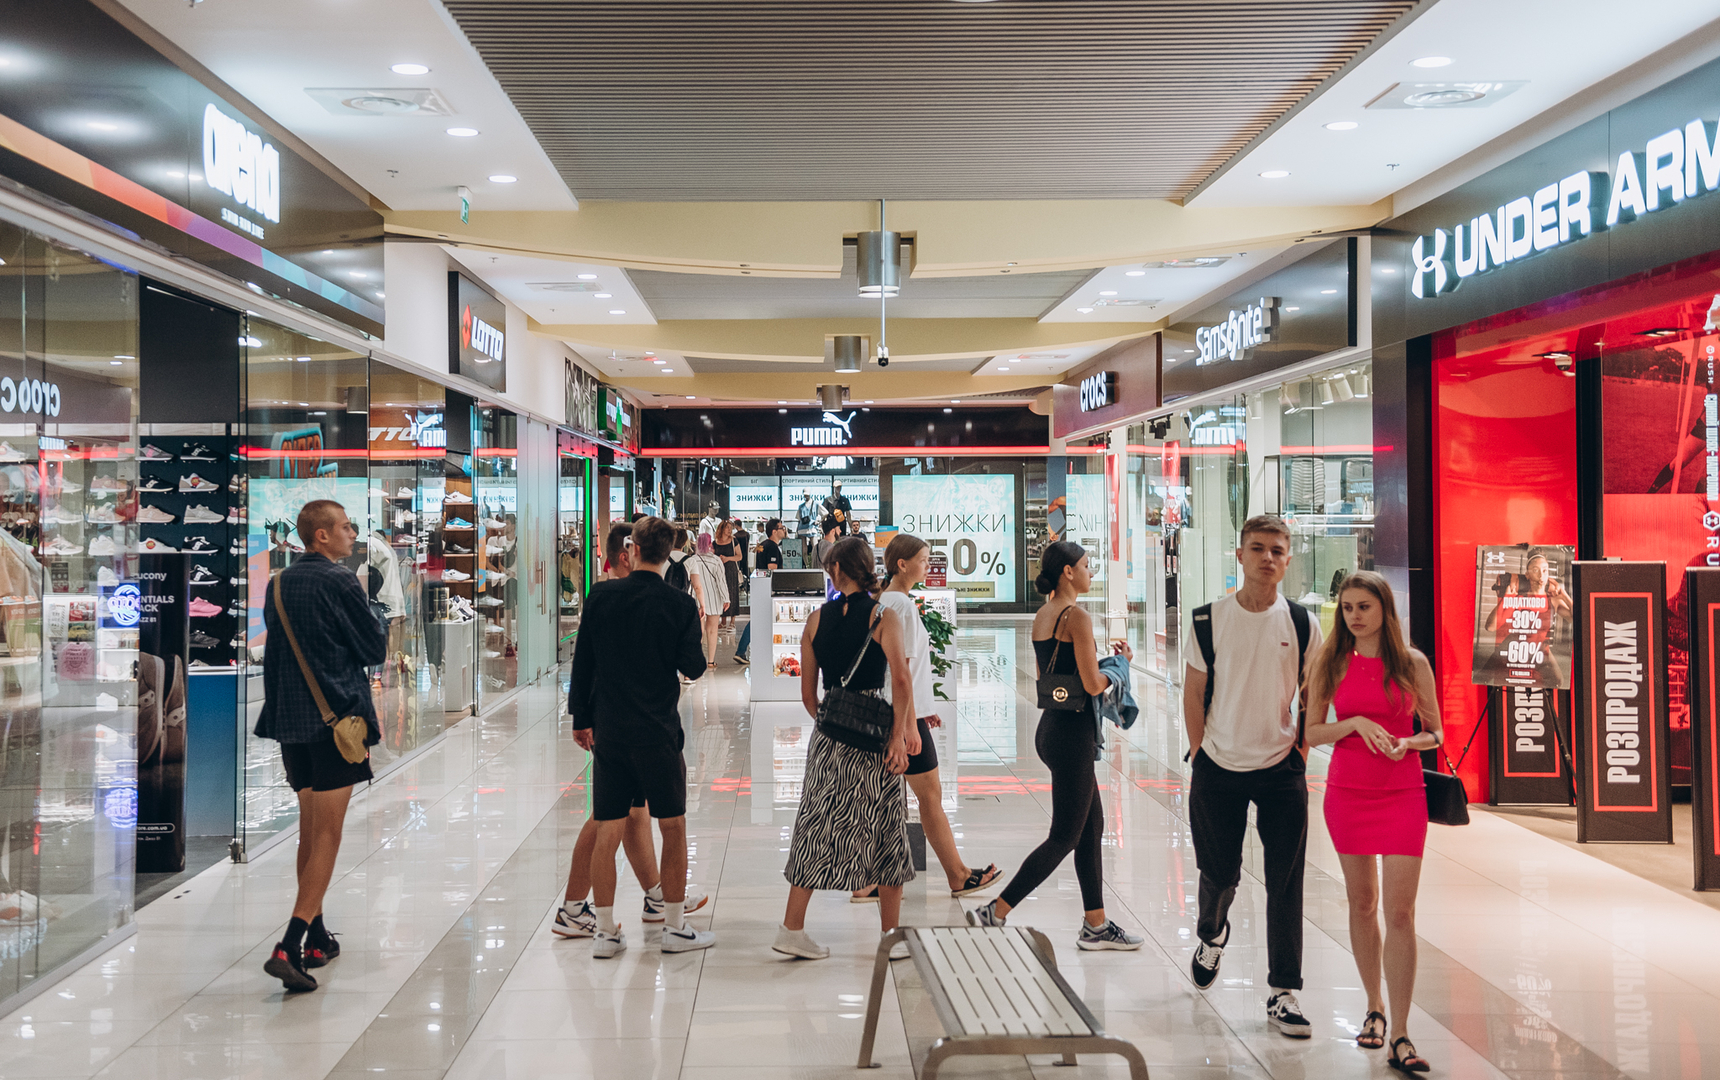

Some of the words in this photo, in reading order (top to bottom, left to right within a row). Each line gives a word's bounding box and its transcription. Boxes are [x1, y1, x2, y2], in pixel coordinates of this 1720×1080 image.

[202, 102, 280, 224] arena
[1454, 169, 1592, 278] UNDER
[471, 315, 504, 362] LOTTO
[1195, 302, 1264, 366] Samsonite
[1080, 370, 1107, 413] crocs
[736, 494, 773, 502] ЗНИЖКИ
[846, 494, 878, 502] НИЖКИ
[902, 514, 1006, 533] ЗНИЖКИ
[1503, 596, 1546, 609] ДОДАТКОВО
[1506, 611, 1542, 629] -30%
[1500, 641, 1544, 664] -60%
[1604, 620, 1643, 783] РОЗПРОДАЖ
